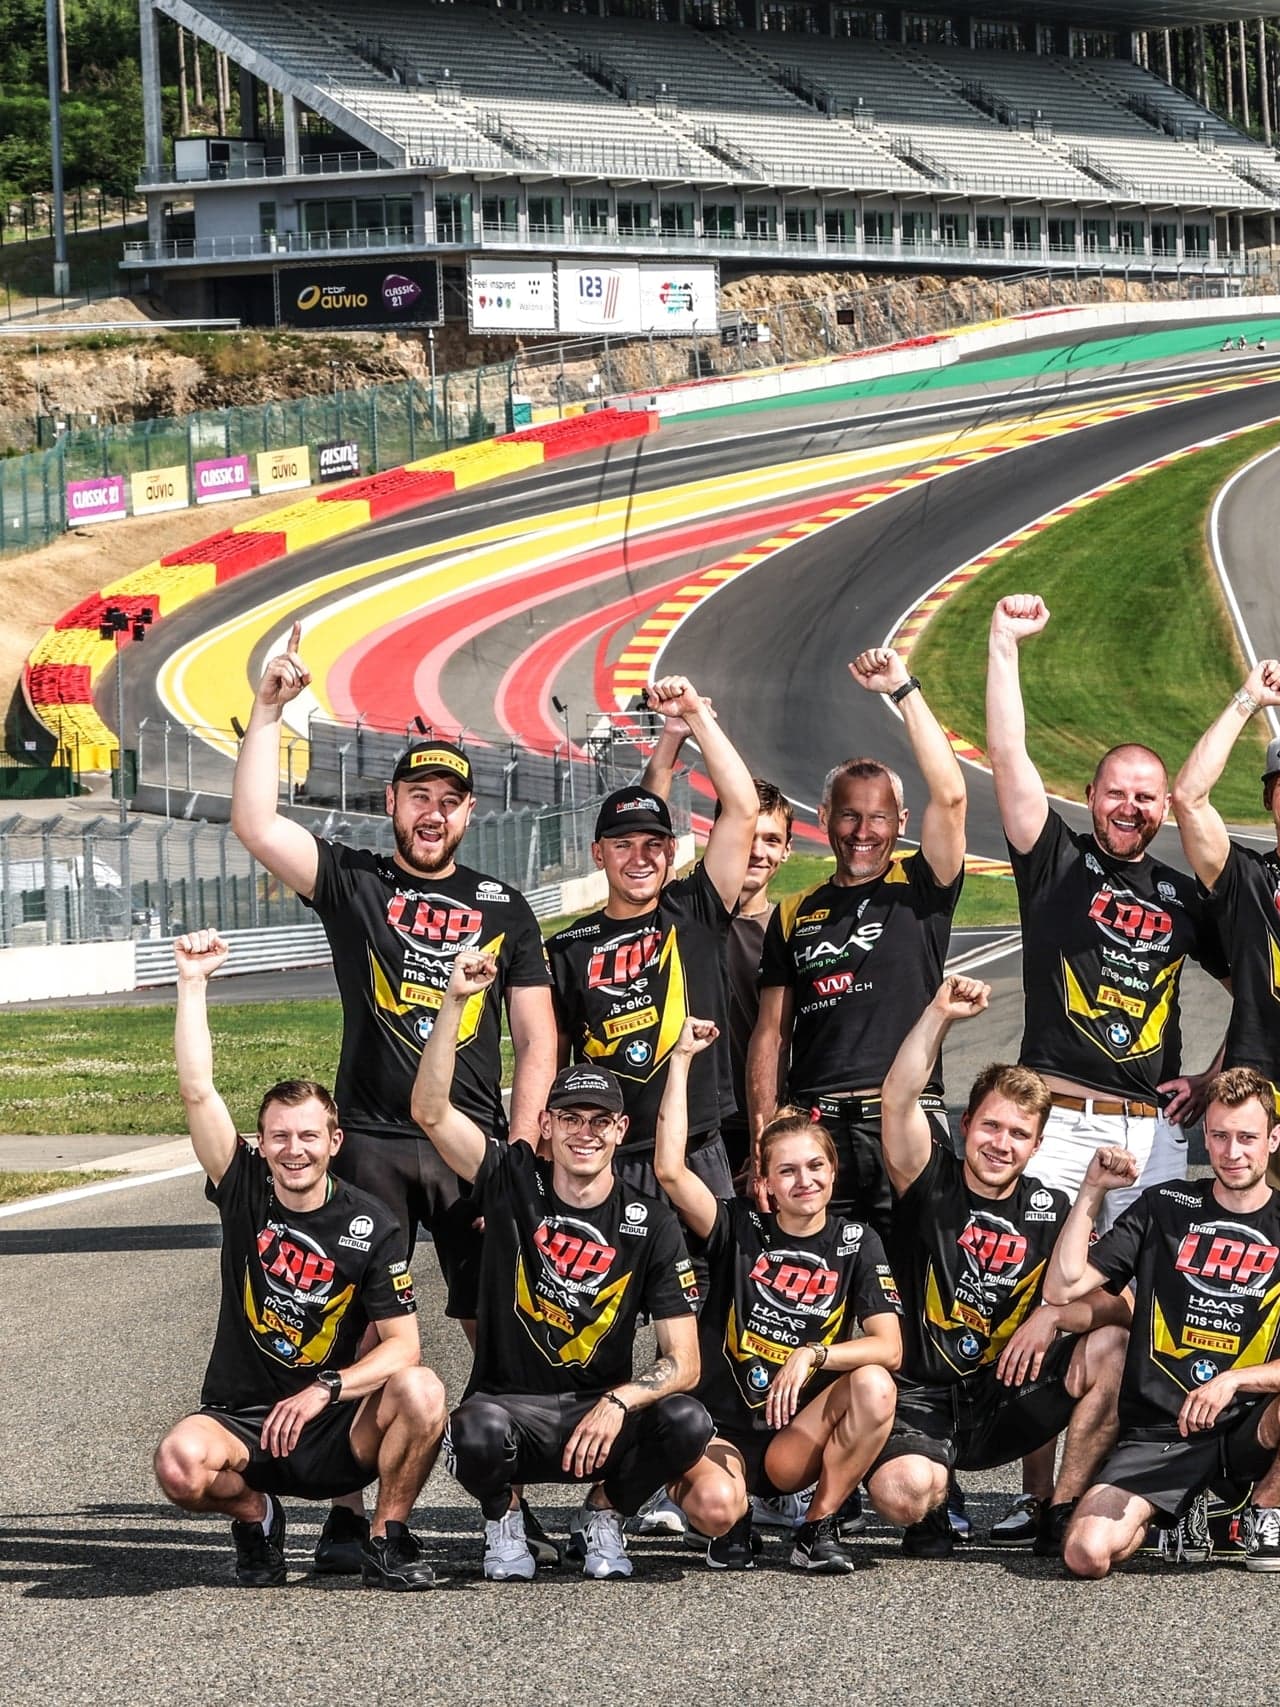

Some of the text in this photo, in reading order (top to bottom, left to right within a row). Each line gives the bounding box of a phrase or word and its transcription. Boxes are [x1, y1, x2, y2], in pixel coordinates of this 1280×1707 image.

[385, 284, 415, 297] CLASSIC
[579, 276, 602, 298] 123
[321, 294, 368, 309] auvio
[391, 296, 402, 307] 21
[201, 468, 235, 488] CLASSIC
[271, 463, 298, 480] auvio
[73, 487, 108, 510] CLASSIC
[146, 483, 174, 501] auvio
[1136, 939, 1170, 954] Poland
[403, 967, 450, 988] ms-ek
[405, 987, 442, 1005] PIREL
[609, 994, 652, 1016] s-eko
[609, 1012, 654, 1035] PIRELLI
[1025, 1212, 1055, 1220] PITBULL
[1189, 1222, 1216, 1236] team
[340, 1238, 371, 1250] PITBULL
[1175, 1232, 1280, 1283] LRP
[565, 1279, 599, 1296] Poland
[984, 1273, 1018, 1287] Poland
[1230, 1283, 1266, 1298] Poland
[796, 1303, 831, 1318] Poland
[1189, 1295, 1245, 1318] HAAS
[752, 1302, 806, 1331] HAAS
[1186, 1313, 1241, 1333] ms-eko
[747, 1319, 800, 1345] ms-eko
[1187, 1331, 1235, 1351] PIRELLI
